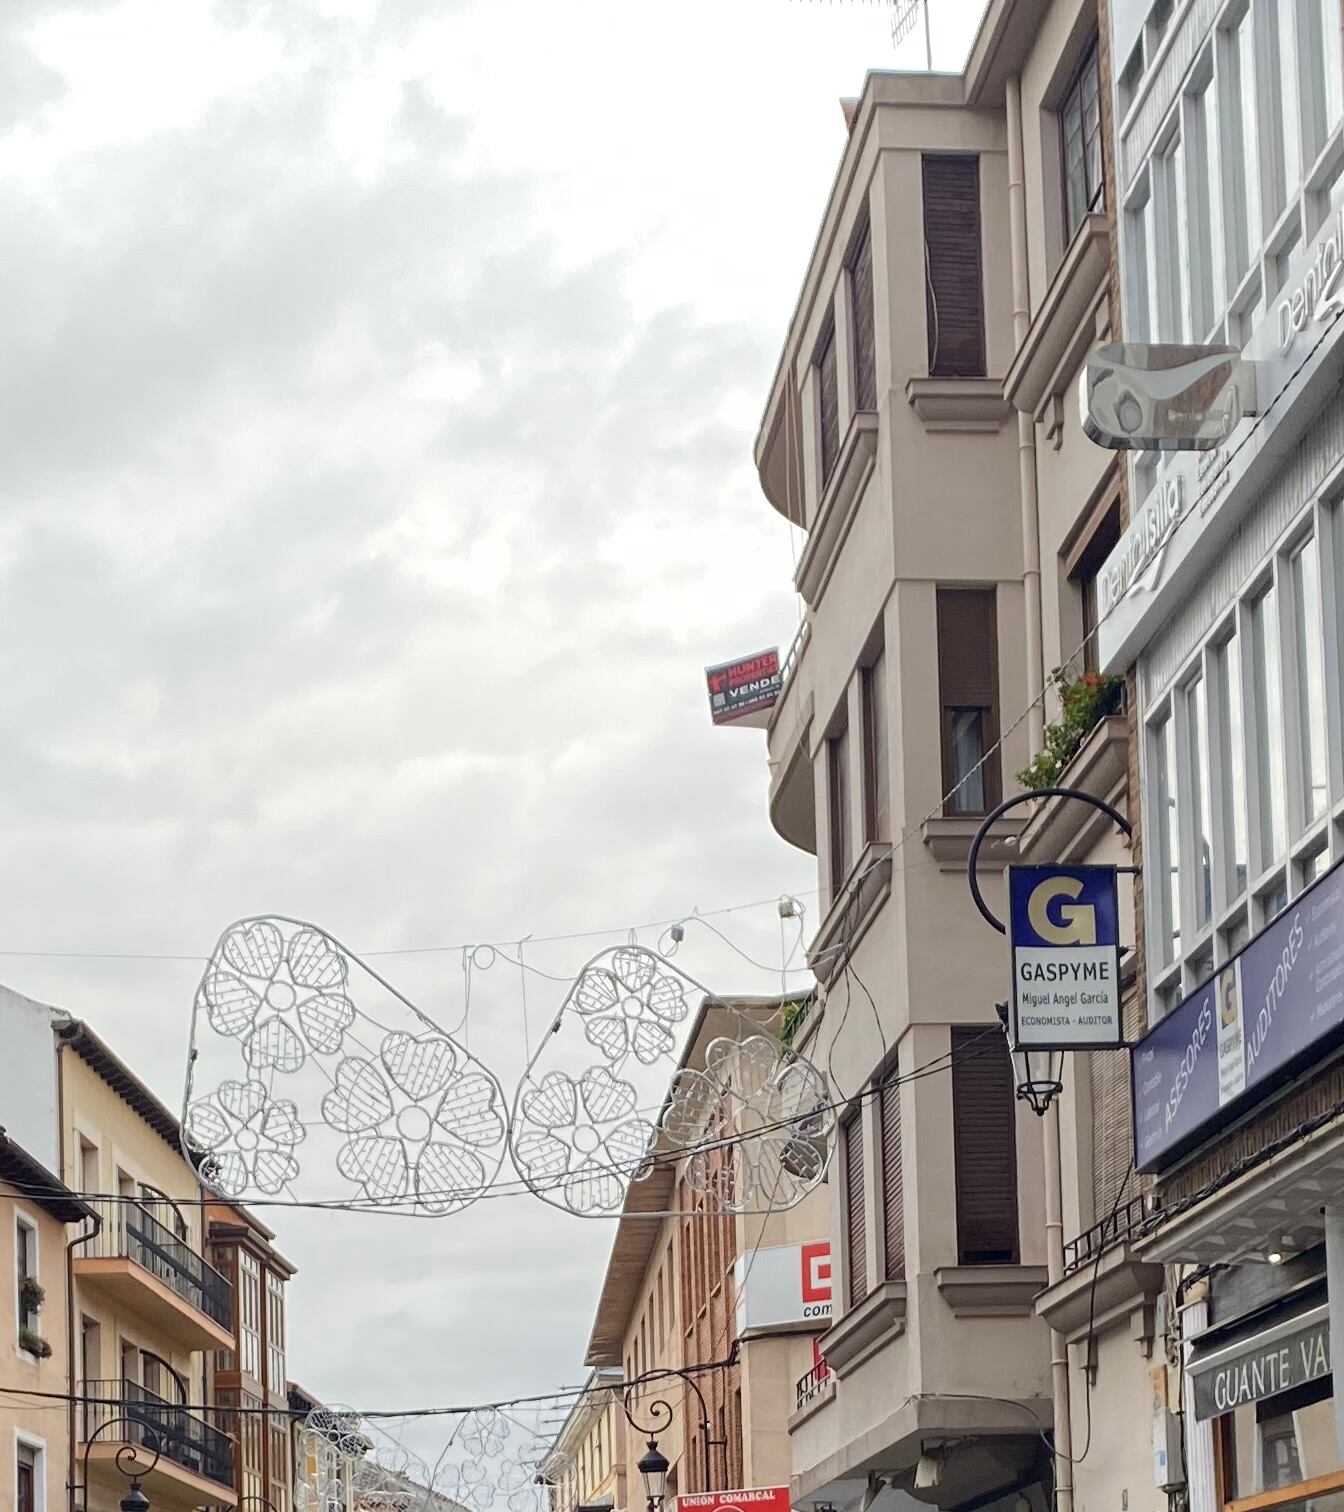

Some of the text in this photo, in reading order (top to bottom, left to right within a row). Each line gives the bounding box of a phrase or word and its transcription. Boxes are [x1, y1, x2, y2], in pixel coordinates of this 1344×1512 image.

[728, 675, 781, 698] VENDE
[1027, 875, 1097, 945] G
[1020, 961, 1110, 982] GASPYME
[1022, 992, 1051, 1008] Miguel
[1080, 990, 1109, 1005] García
[1246, 912, 1305, 1078] AUDITORES
[1021, 1016, 1071, 1026] ECONOMISTA
[1078, 1015, 1113, 1025] AUDITOR
[1164, 997, 1213, 1134] ASESORES
[1214, 1333, 1328, 1410] GUANTE VA
[718, 1489, 776, 1504] COMARCAL
